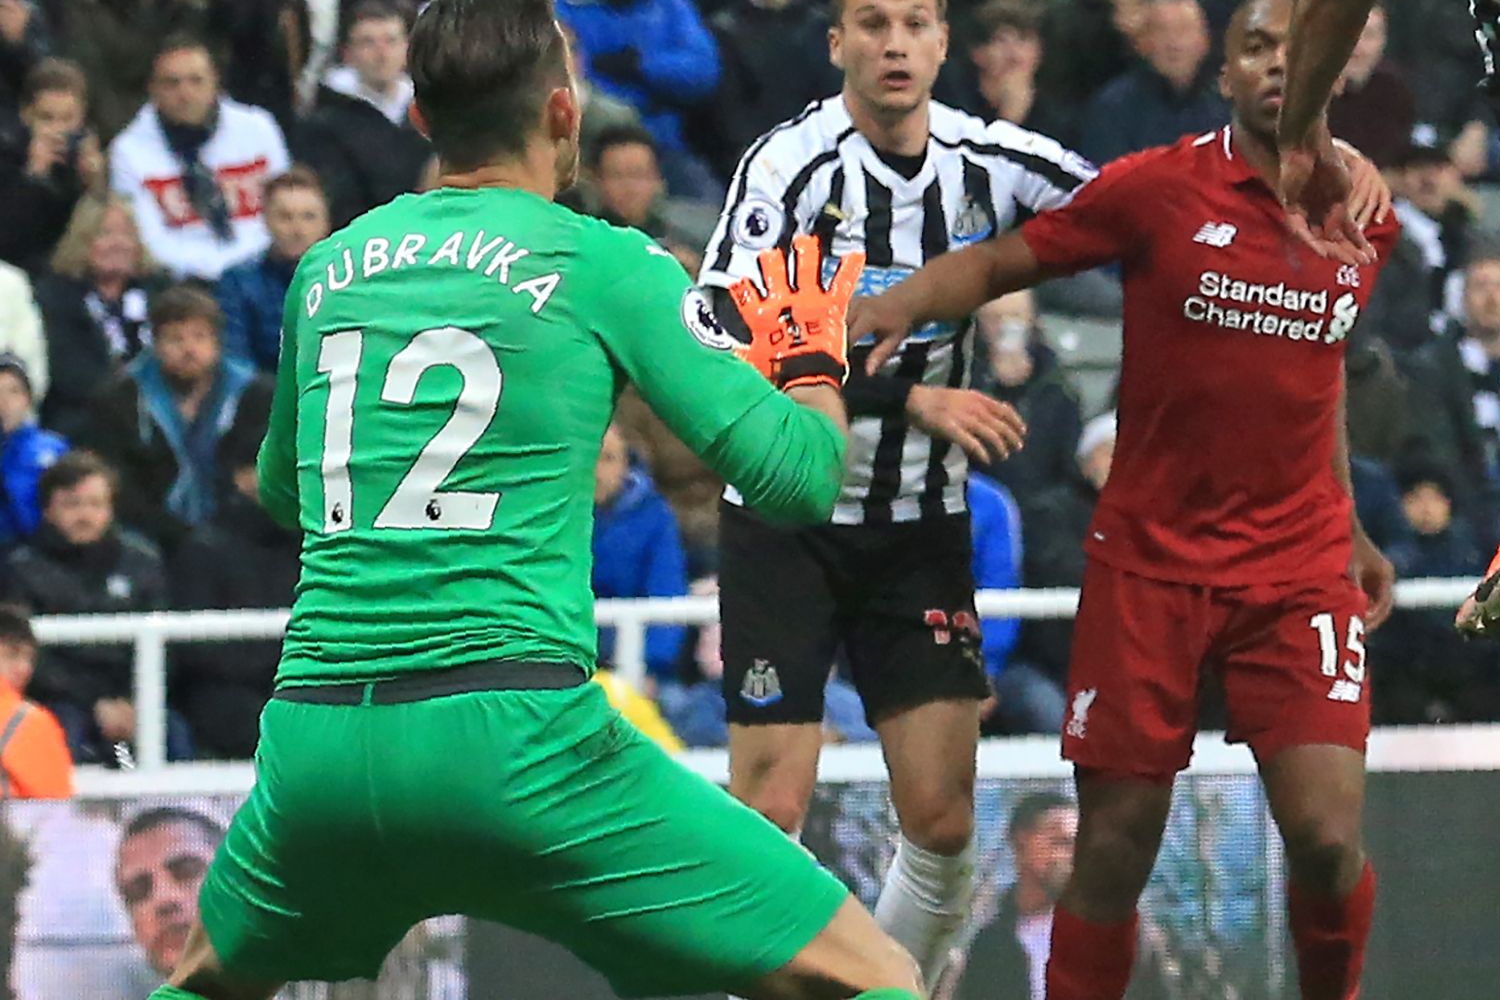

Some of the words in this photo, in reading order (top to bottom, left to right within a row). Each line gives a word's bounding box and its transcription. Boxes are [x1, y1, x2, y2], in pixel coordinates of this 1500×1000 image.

[1183, 296, 1323, 341] Chartered
[1199, 270, 1327, 315] Standard
[317, 326, 502, 533] 12
[1309, 613, 1366, 684] 15
